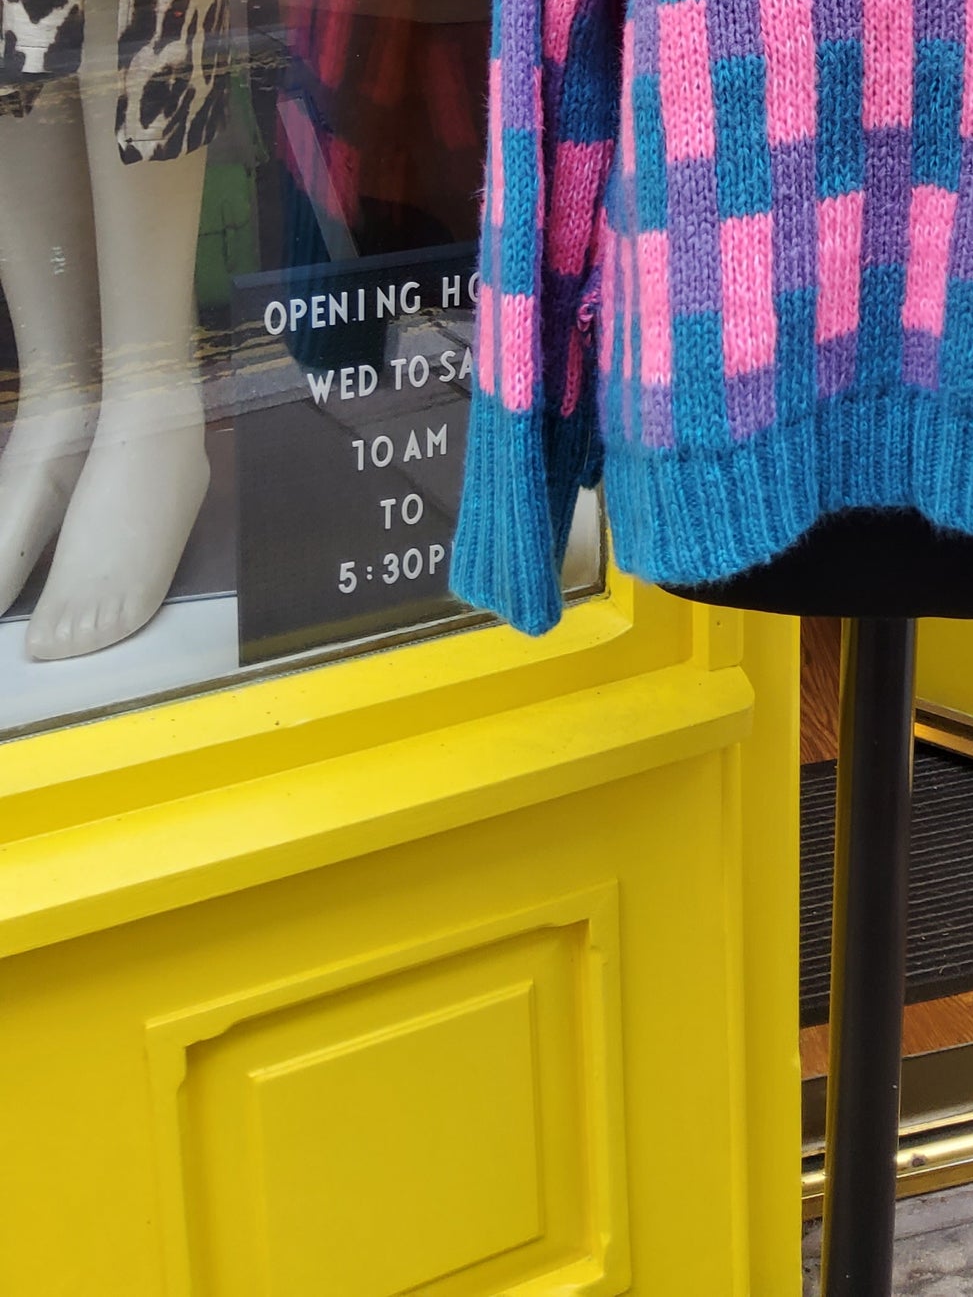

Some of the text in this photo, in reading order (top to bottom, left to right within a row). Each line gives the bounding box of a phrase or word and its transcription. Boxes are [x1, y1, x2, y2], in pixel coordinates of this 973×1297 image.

[264, 281, 421, 335] OPENING
[307, 364, 378, 404] WED
[390, 355, 430, 390] TO
[380, 493, 424, 530] TO
[338, 541, 454, 594] 5:30P
